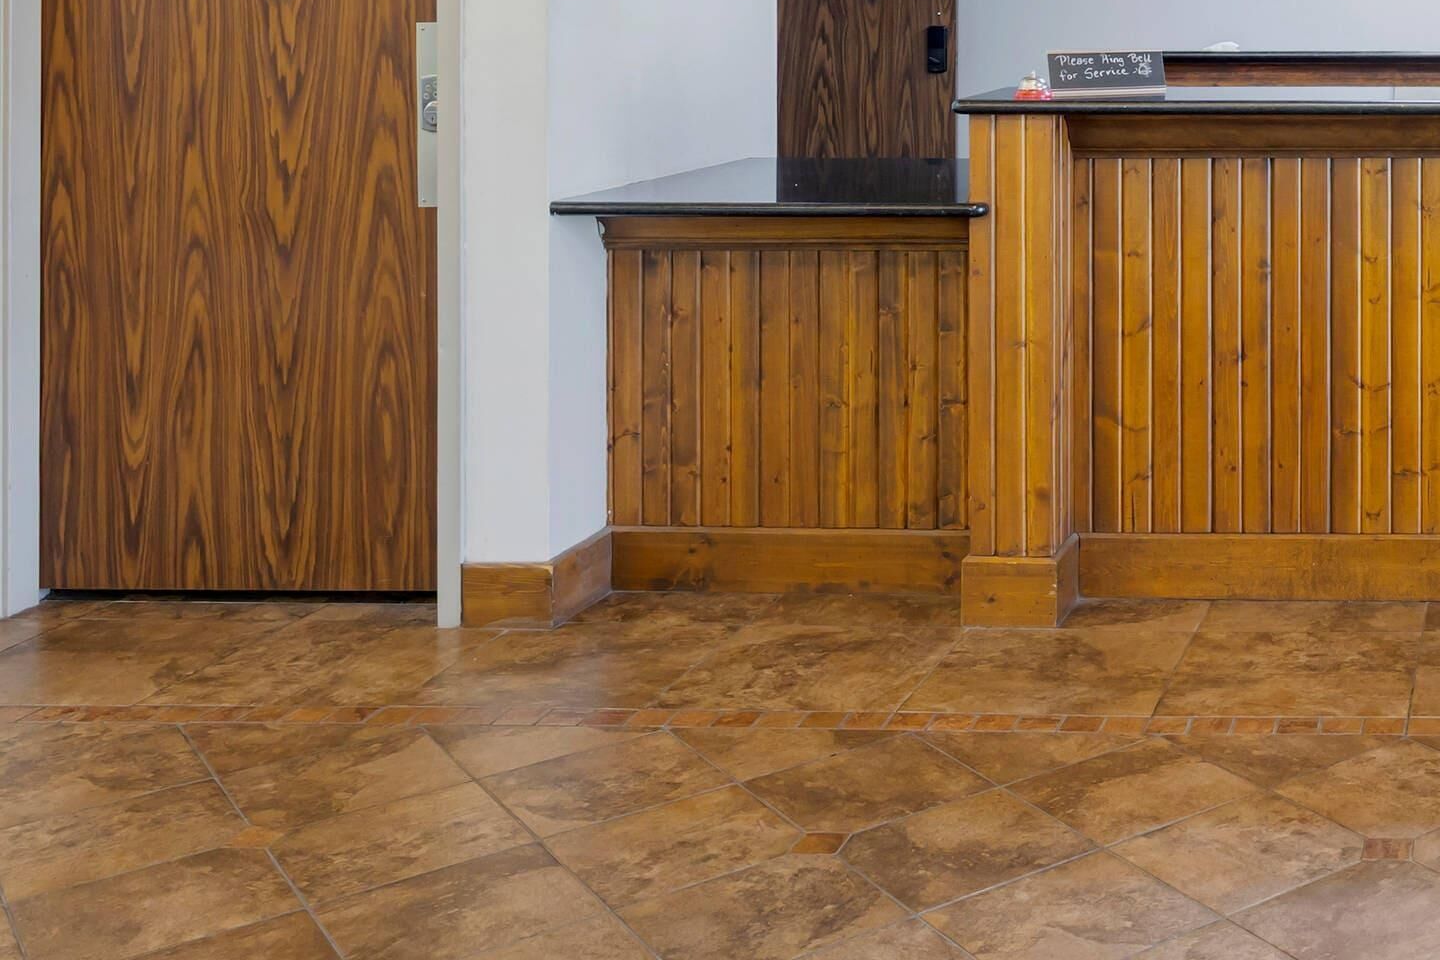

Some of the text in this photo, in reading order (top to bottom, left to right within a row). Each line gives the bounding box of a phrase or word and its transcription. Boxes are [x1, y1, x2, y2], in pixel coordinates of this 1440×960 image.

[1055, 55, 1094, 66] Please
[1128, 53, 1152, 64] Bell
[1059, 67, 1129, 82] for Service
